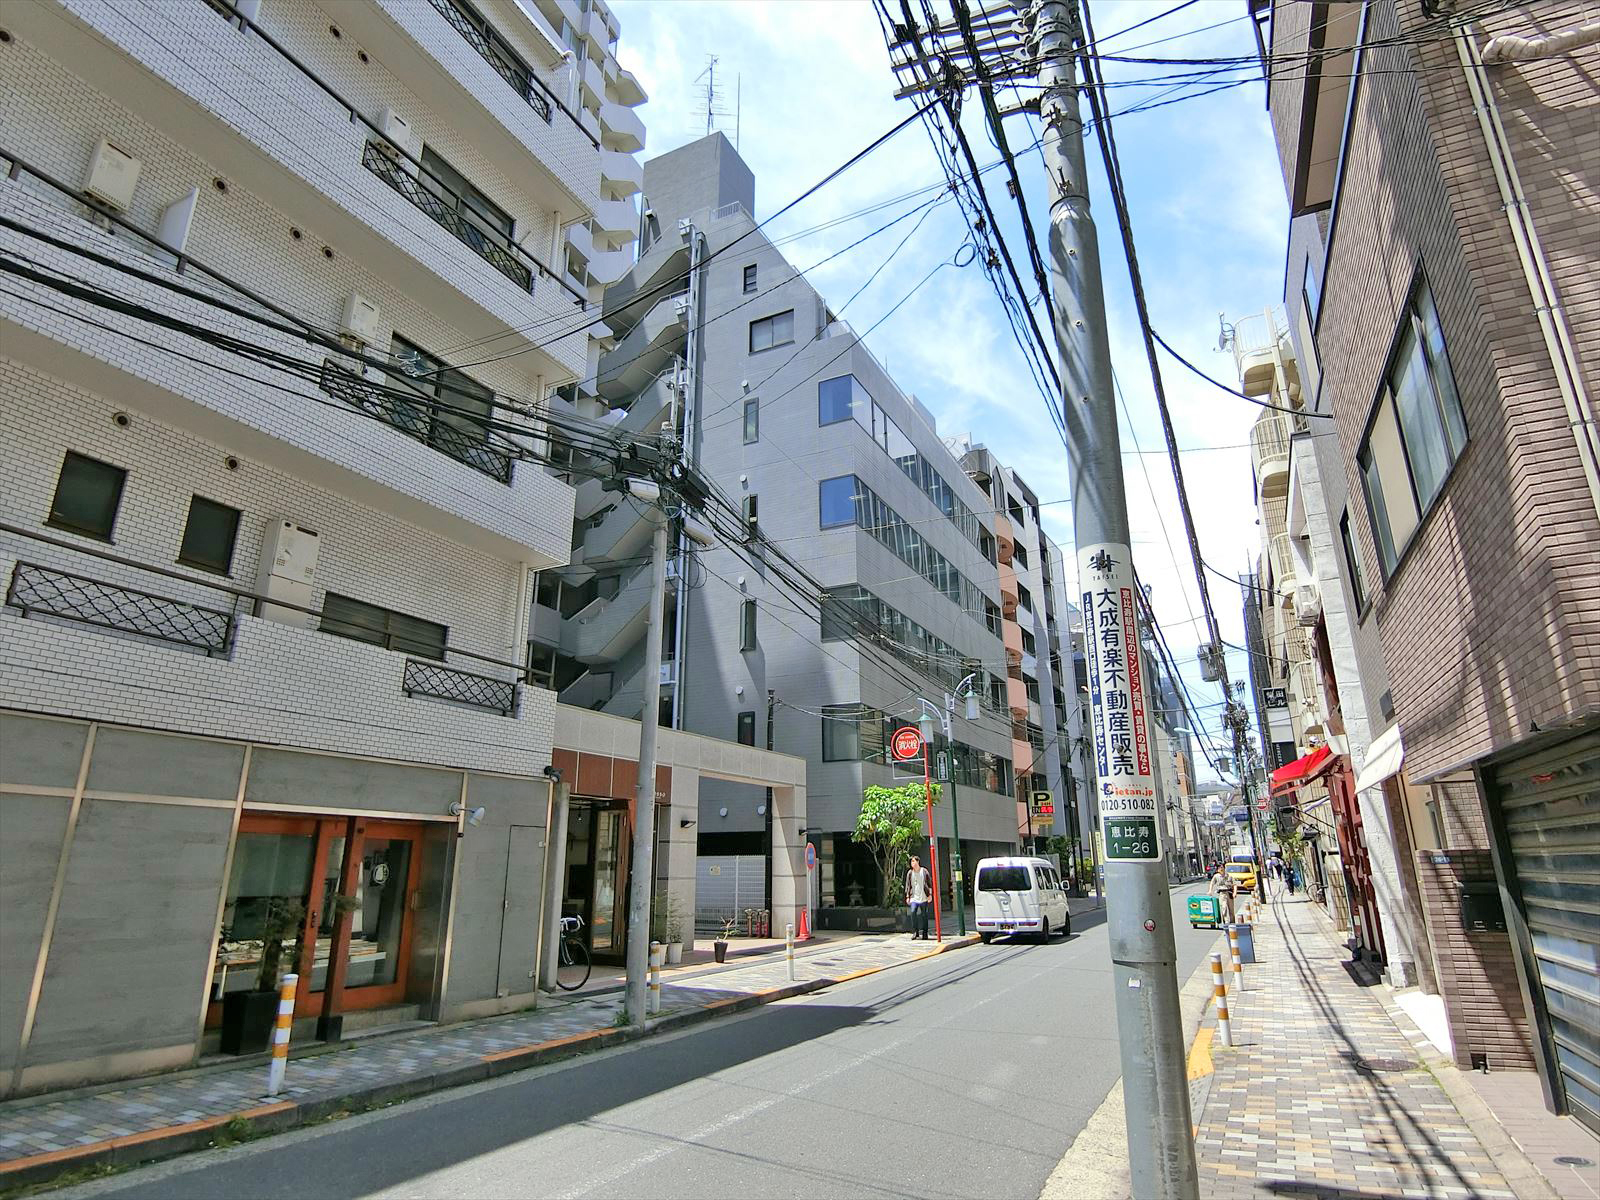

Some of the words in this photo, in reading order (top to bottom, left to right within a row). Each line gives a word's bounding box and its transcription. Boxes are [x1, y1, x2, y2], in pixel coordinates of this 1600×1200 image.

[1096, 588, 1135, 776] 大成有楽不動産販売
[898, 740, 918, 750] 消火栓
[1115, 787, 1153, 797] ietan.jp
[1034, 793, 1050, 805] P
[1101, 799, 1155, 811] 0120-510-082
[1111, 826, 1150, 838] 恵比寿
[1113, 842, 1150, 854] 1-26
